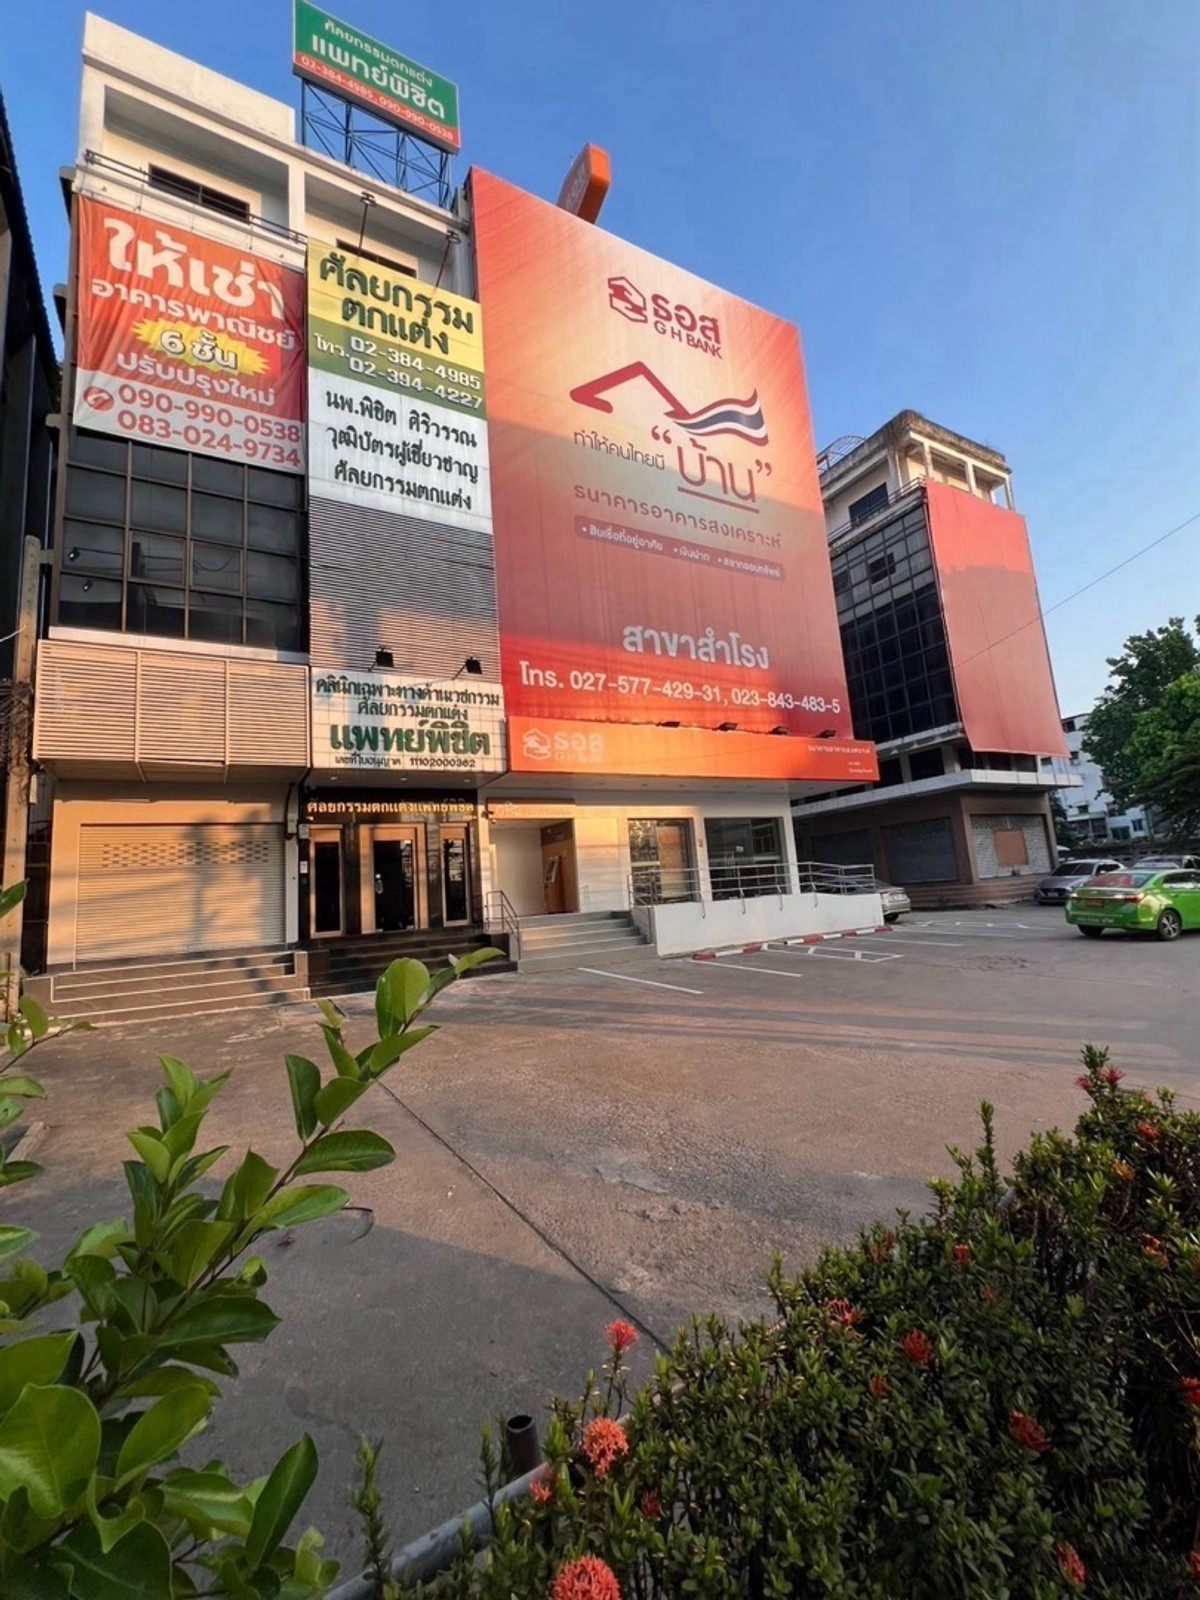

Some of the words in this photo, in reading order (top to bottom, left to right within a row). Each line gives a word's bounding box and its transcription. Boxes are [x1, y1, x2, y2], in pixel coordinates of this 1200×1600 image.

[312, 34, 445, 119] แพทย์พิชิต
[324, 19, 433, 87] ศัลยกรรมตกแต่ง
[379, 96, 454, 141] 090-990-0538
[103, 218, 286, 321] ให้เช่า
[319, 251, 474, 334] ศัลยกรรม
[91, 278, 295, 350] อาคารพาณิชย์
[341, 297, 449, 356] ตกแต่ง
[651, 293, 721, 345] ธอส
[160, 329, 186, 356] 6
[190, 329, 238, 370] ชั้น
[350, 335, 481, 391] 02-384-4985
[116, 351, 275, 407] ปรับปรุงใหม่
[349, 356, 483, 410] 02-394-4227
[117, 409, 301, 467] 083-024-9734
[118, 383, 300, 444] 090-990-0538
[326, 390, 397, 426] นพ.พิชิต
[408, 409, 478, 448] ศิริวรรณ
[326, 425, 479, 484] วุฒิบัตรผู้เชี่ยวชาญ
[573, 429, 665, 470] ทำให้คนไทยมี
[334, 459, 472, 510] ศัลยกรรมตกแต่ง
[573, 484, 782, 549] ธนาคารอาคารสงเคราะห์
[622, 624, 769, 669] สาขาสำโรง
[358, 695, 468, 720] ศัลยกรรมตกแต่ง
[518, 660, 564, 689] โทร.
[731, 687, 841, 714] 023-843-483-5
[330, 719, 491, 756] แพทย์พิชิต
